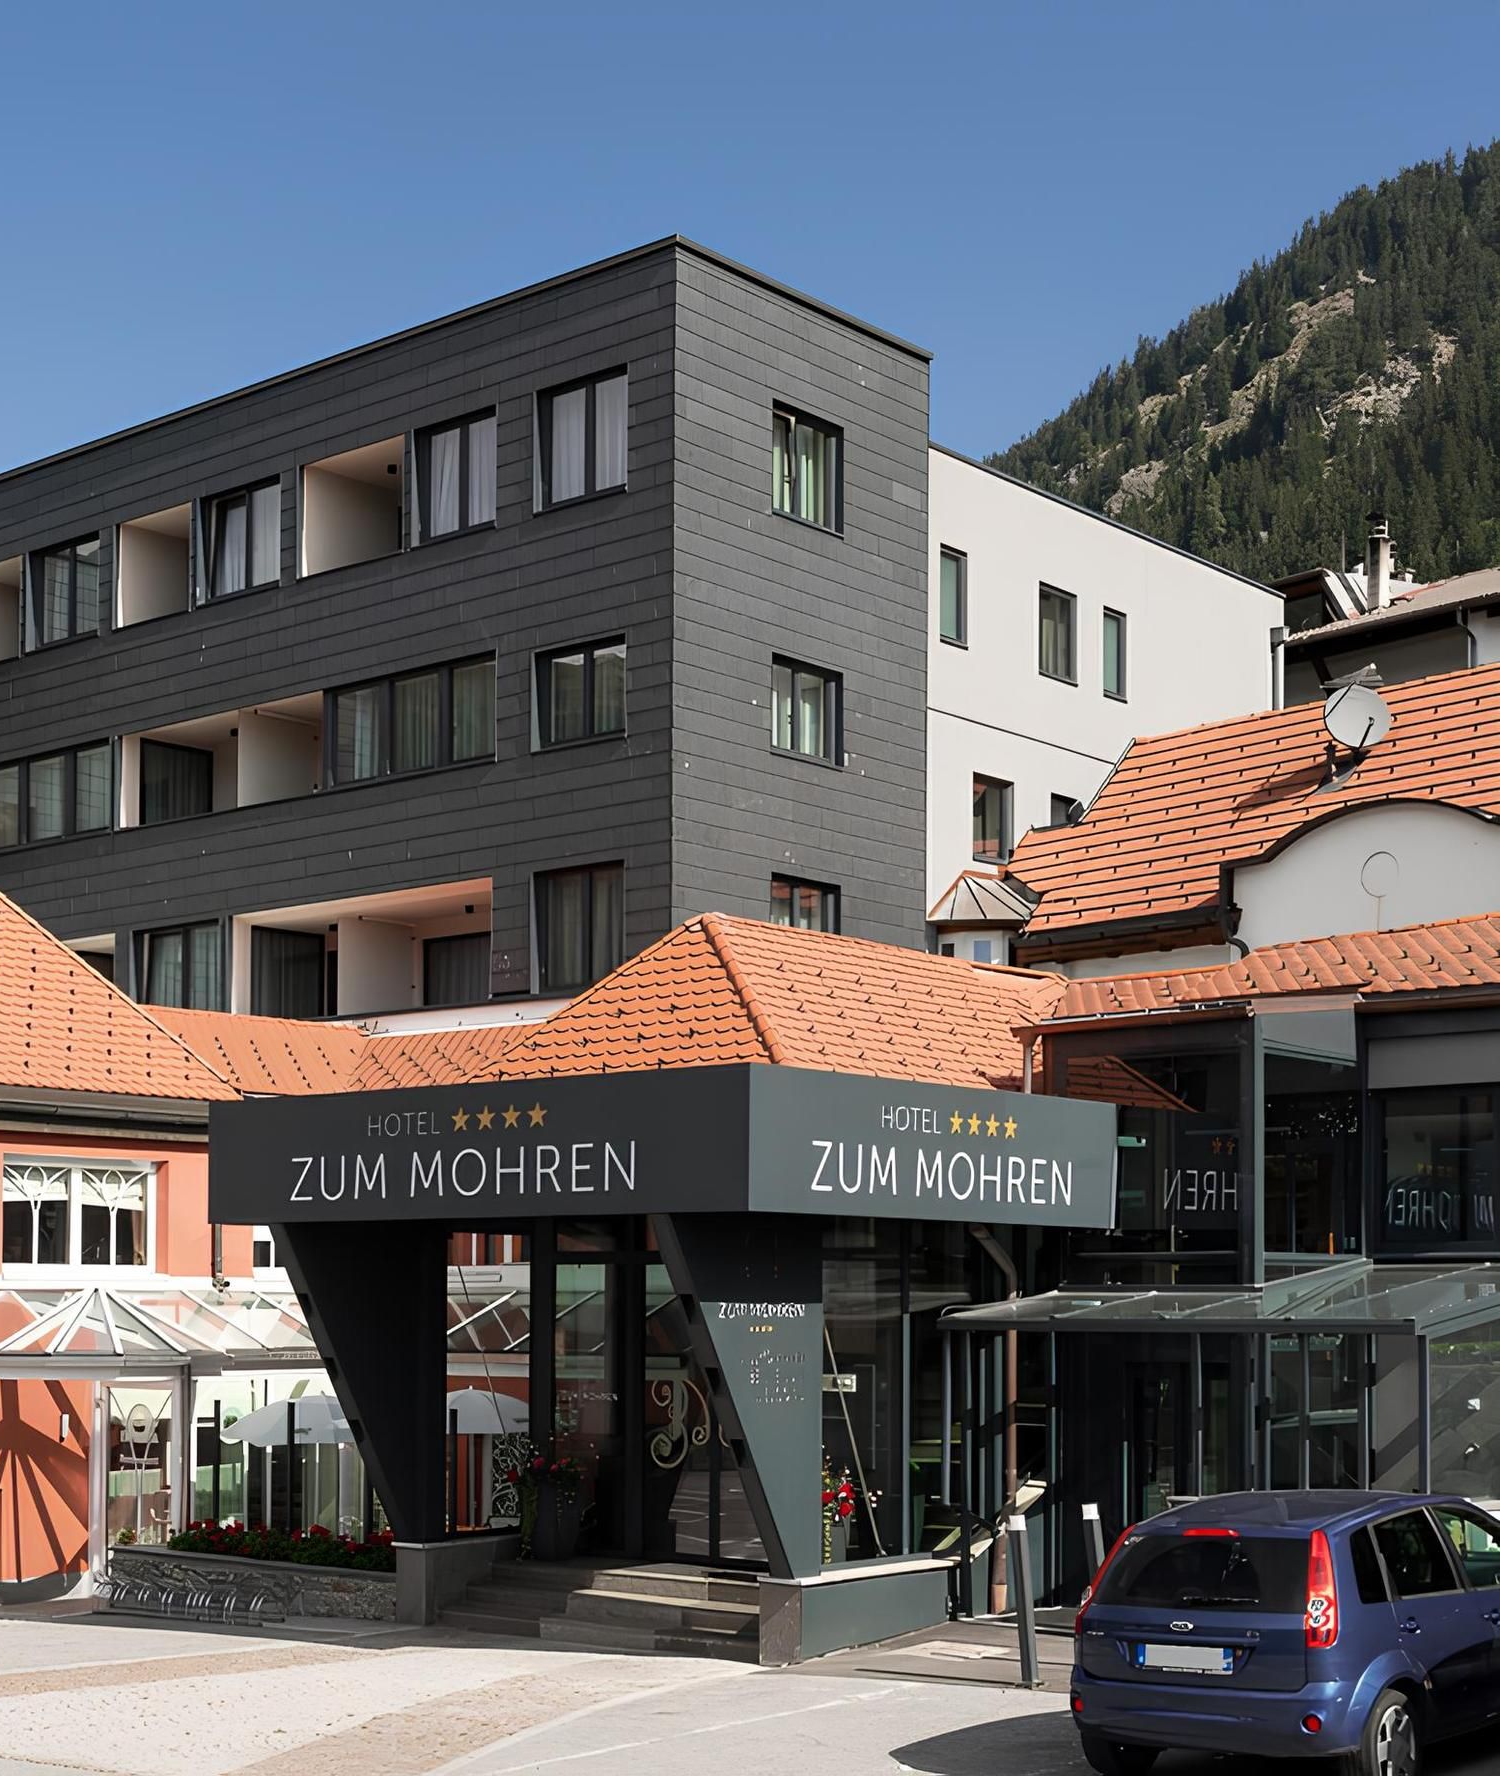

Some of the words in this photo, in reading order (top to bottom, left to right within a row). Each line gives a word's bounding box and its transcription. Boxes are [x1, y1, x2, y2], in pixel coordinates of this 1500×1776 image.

[367, 1111, 441, 1137] HOTEL
[880, 1105, 942, 1134] HOTEL
[290, 1153, 387, 1201] ZUM
[409, 1140, 636, 1199] MOHREN
[810, 1140, 897, 1197] ZUM
[915, 1148, 1073, 1206] MOHREN
